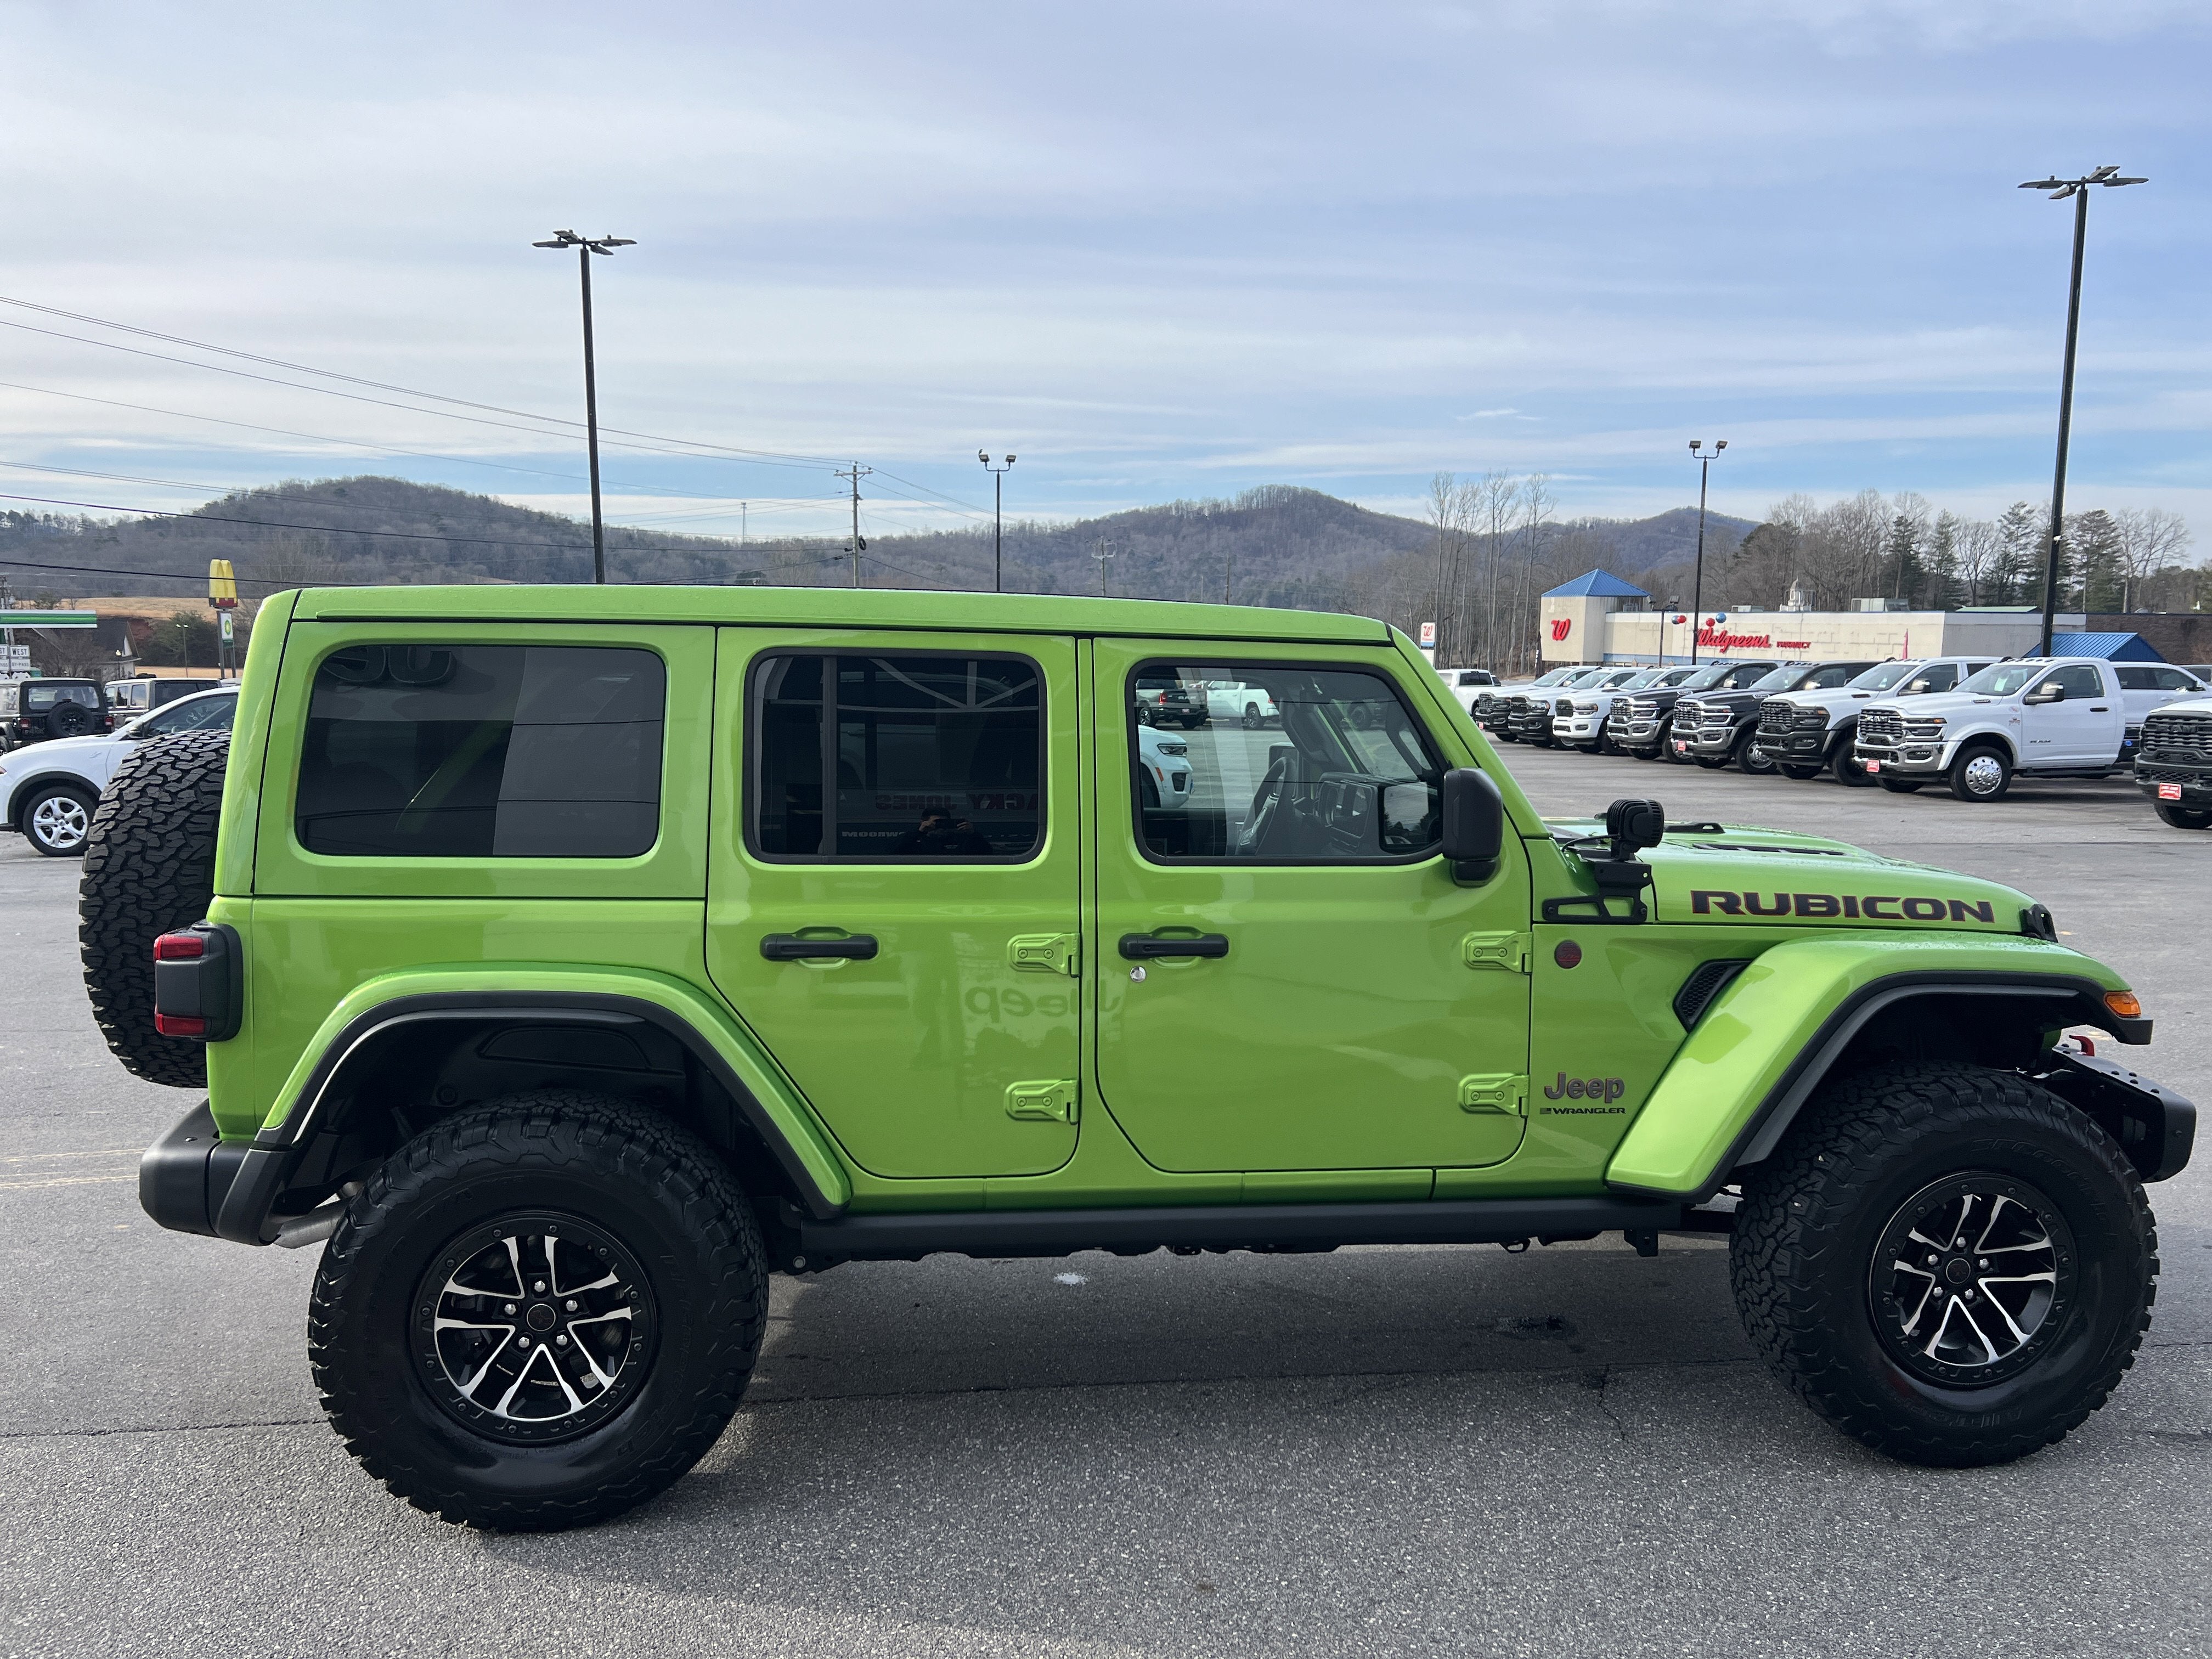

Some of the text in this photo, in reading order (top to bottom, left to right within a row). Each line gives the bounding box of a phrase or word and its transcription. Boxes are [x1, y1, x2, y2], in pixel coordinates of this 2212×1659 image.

[1551, 618, 1571, 641] W
[1697, 627, 1771, 653] Walgreens
[1690, 890, 1995, 923] RUBICON
[1544, 1072, 1625, 1104] Jeep
